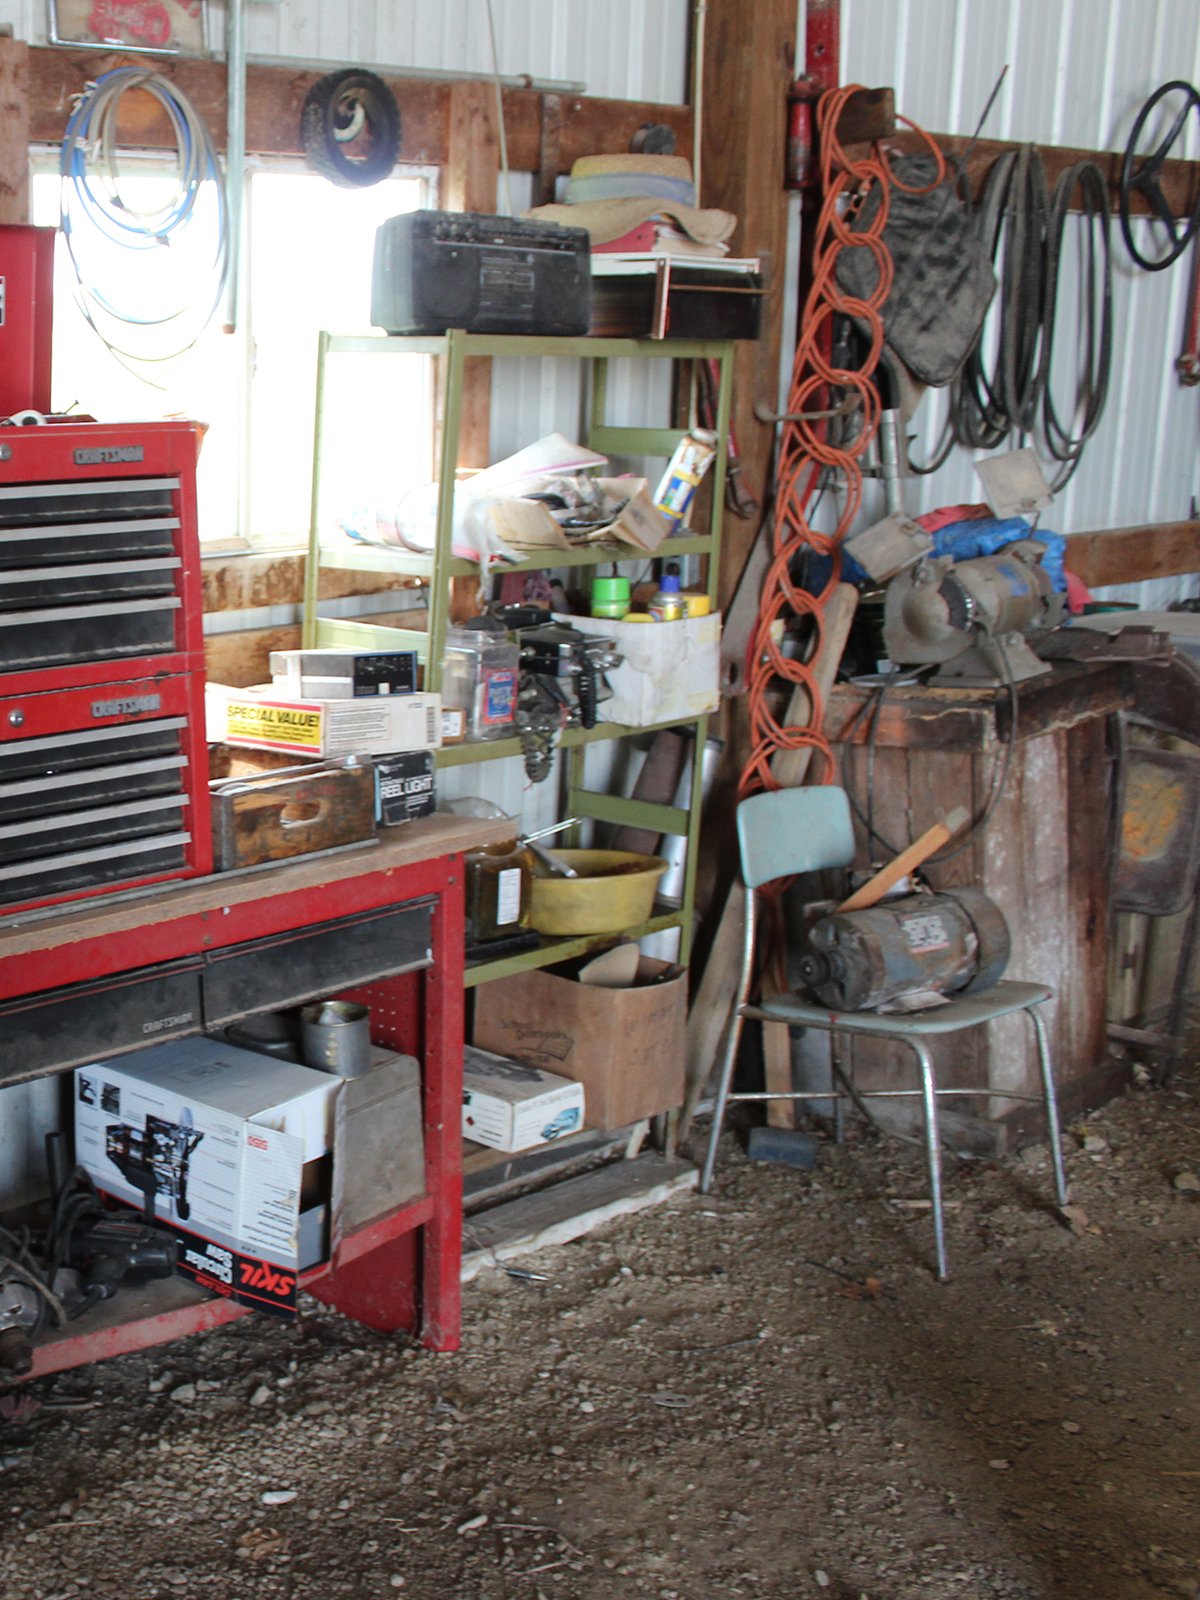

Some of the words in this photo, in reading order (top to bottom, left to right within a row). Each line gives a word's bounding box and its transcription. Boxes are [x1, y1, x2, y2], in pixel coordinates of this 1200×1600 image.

[227, 705, 275, 723] SPECIAL
[277, 711, 320, 728] VALUE!
[380, 783, 405, 799] REEL
[405, 777, 432, 794] LIGHT
[185, 1249, 233, 1284] Circular
[205, 1243, 233, 1268] Saw
[239, 1262, 296, 1296] SKIL
